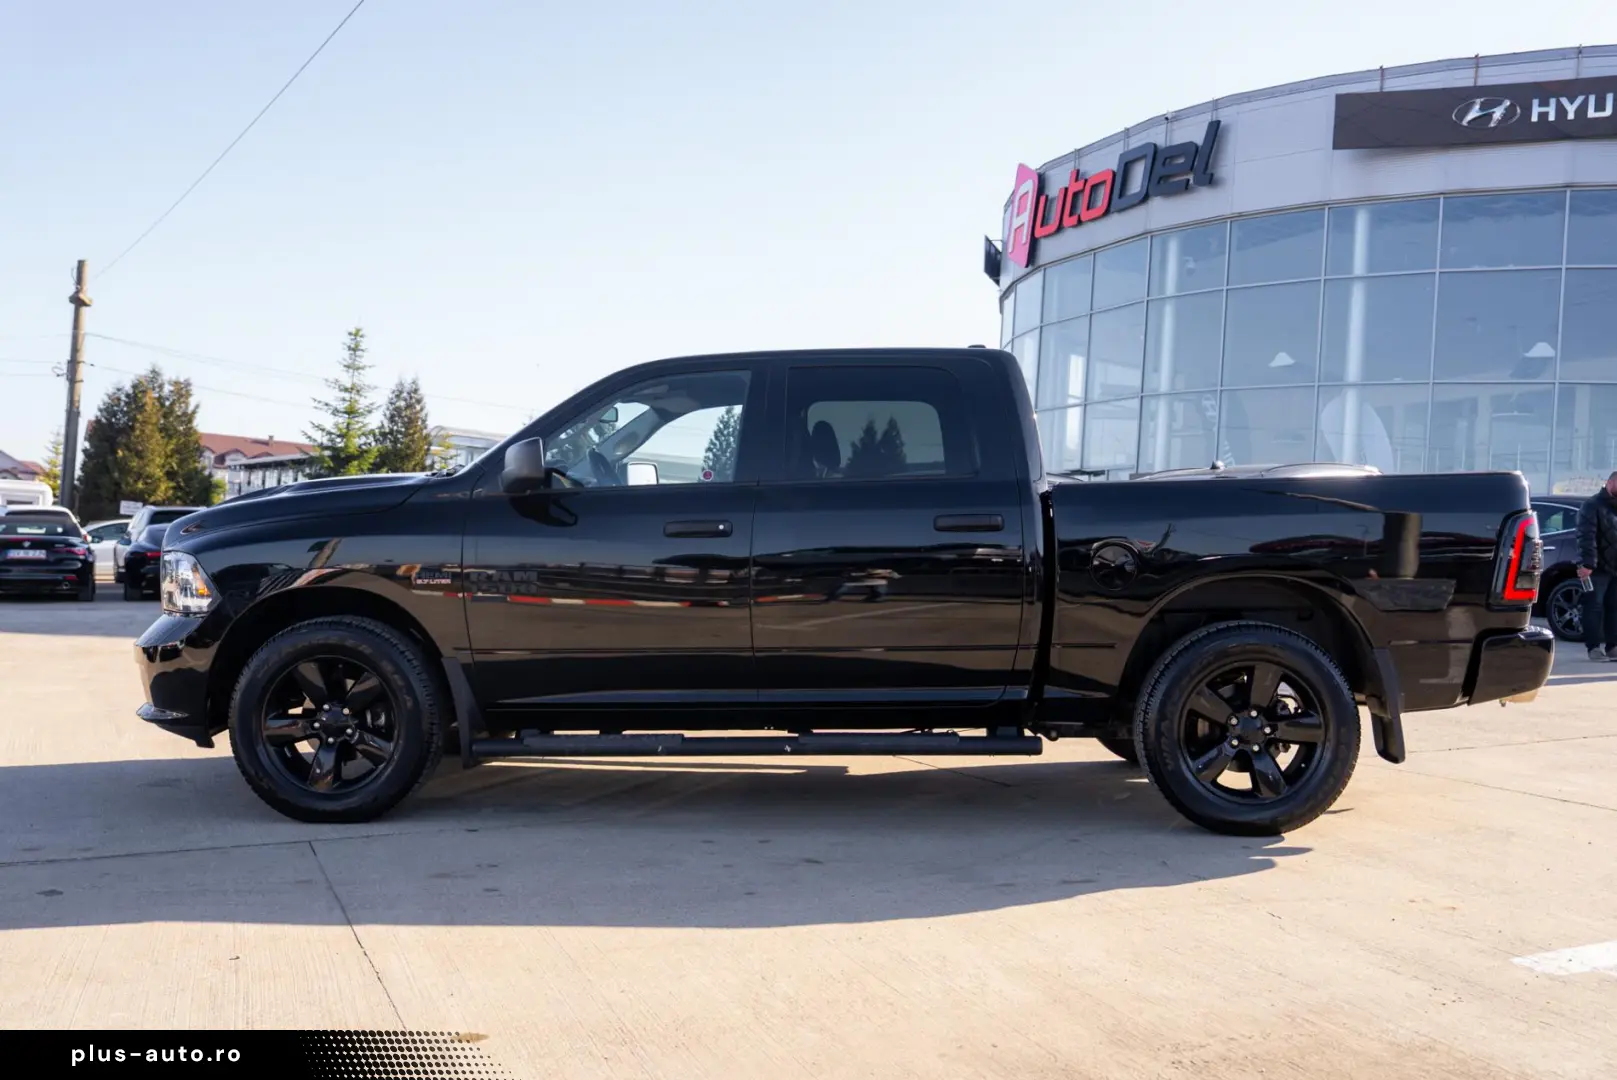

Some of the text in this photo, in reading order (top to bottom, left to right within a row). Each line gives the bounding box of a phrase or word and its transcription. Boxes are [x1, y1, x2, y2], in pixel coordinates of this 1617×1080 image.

[1531, 93, 1614, 123] HYU
[1008, 119, 1222, 254] AutoDel
[469, 570, 539, 582] RAM
